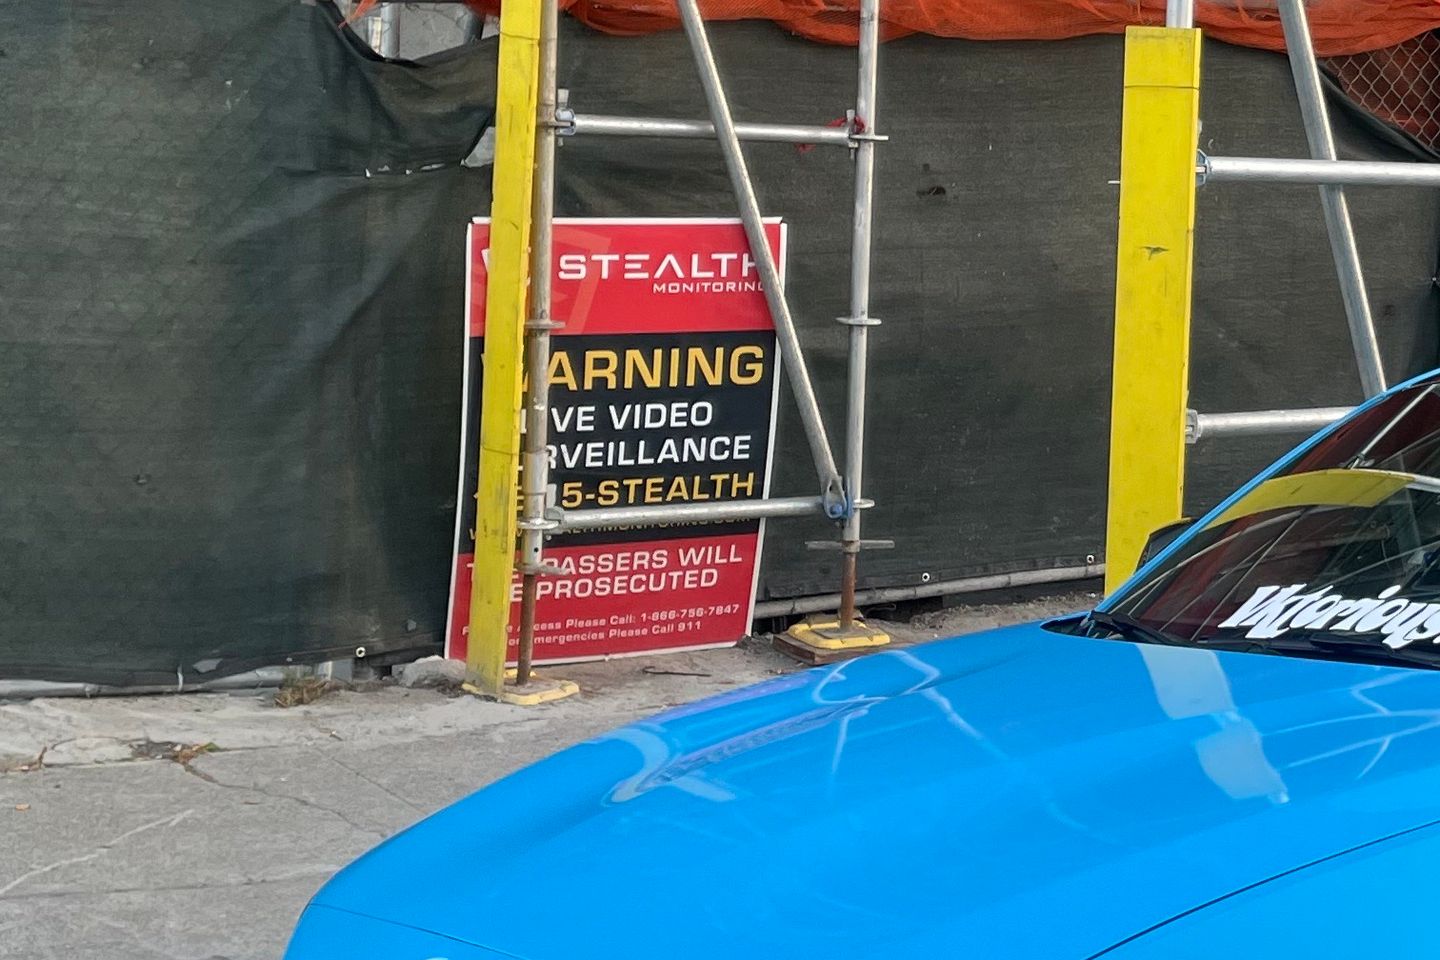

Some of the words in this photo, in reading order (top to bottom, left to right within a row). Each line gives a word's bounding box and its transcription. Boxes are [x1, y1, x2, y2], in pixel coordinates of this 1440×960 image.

[481, 344, 764, 394] ARNING
[608, 400, 713, 431] VIDEO
[517, 434, 752, 472] RVEILLANCE
[473, 471, 755, 509] 5-STEALTH
[678, 543, 743, 568] WILL
[510, 583, 523, 603] E
[535, 568, 718, 601] PROSECUTED
[533, 630, 605, 646] mergencies
[609, 628, 648, 639] Please
[651, 623, 674, 635] Call
[677, 620, 701, 632] 911
[565, 618, 606, 629] Please
